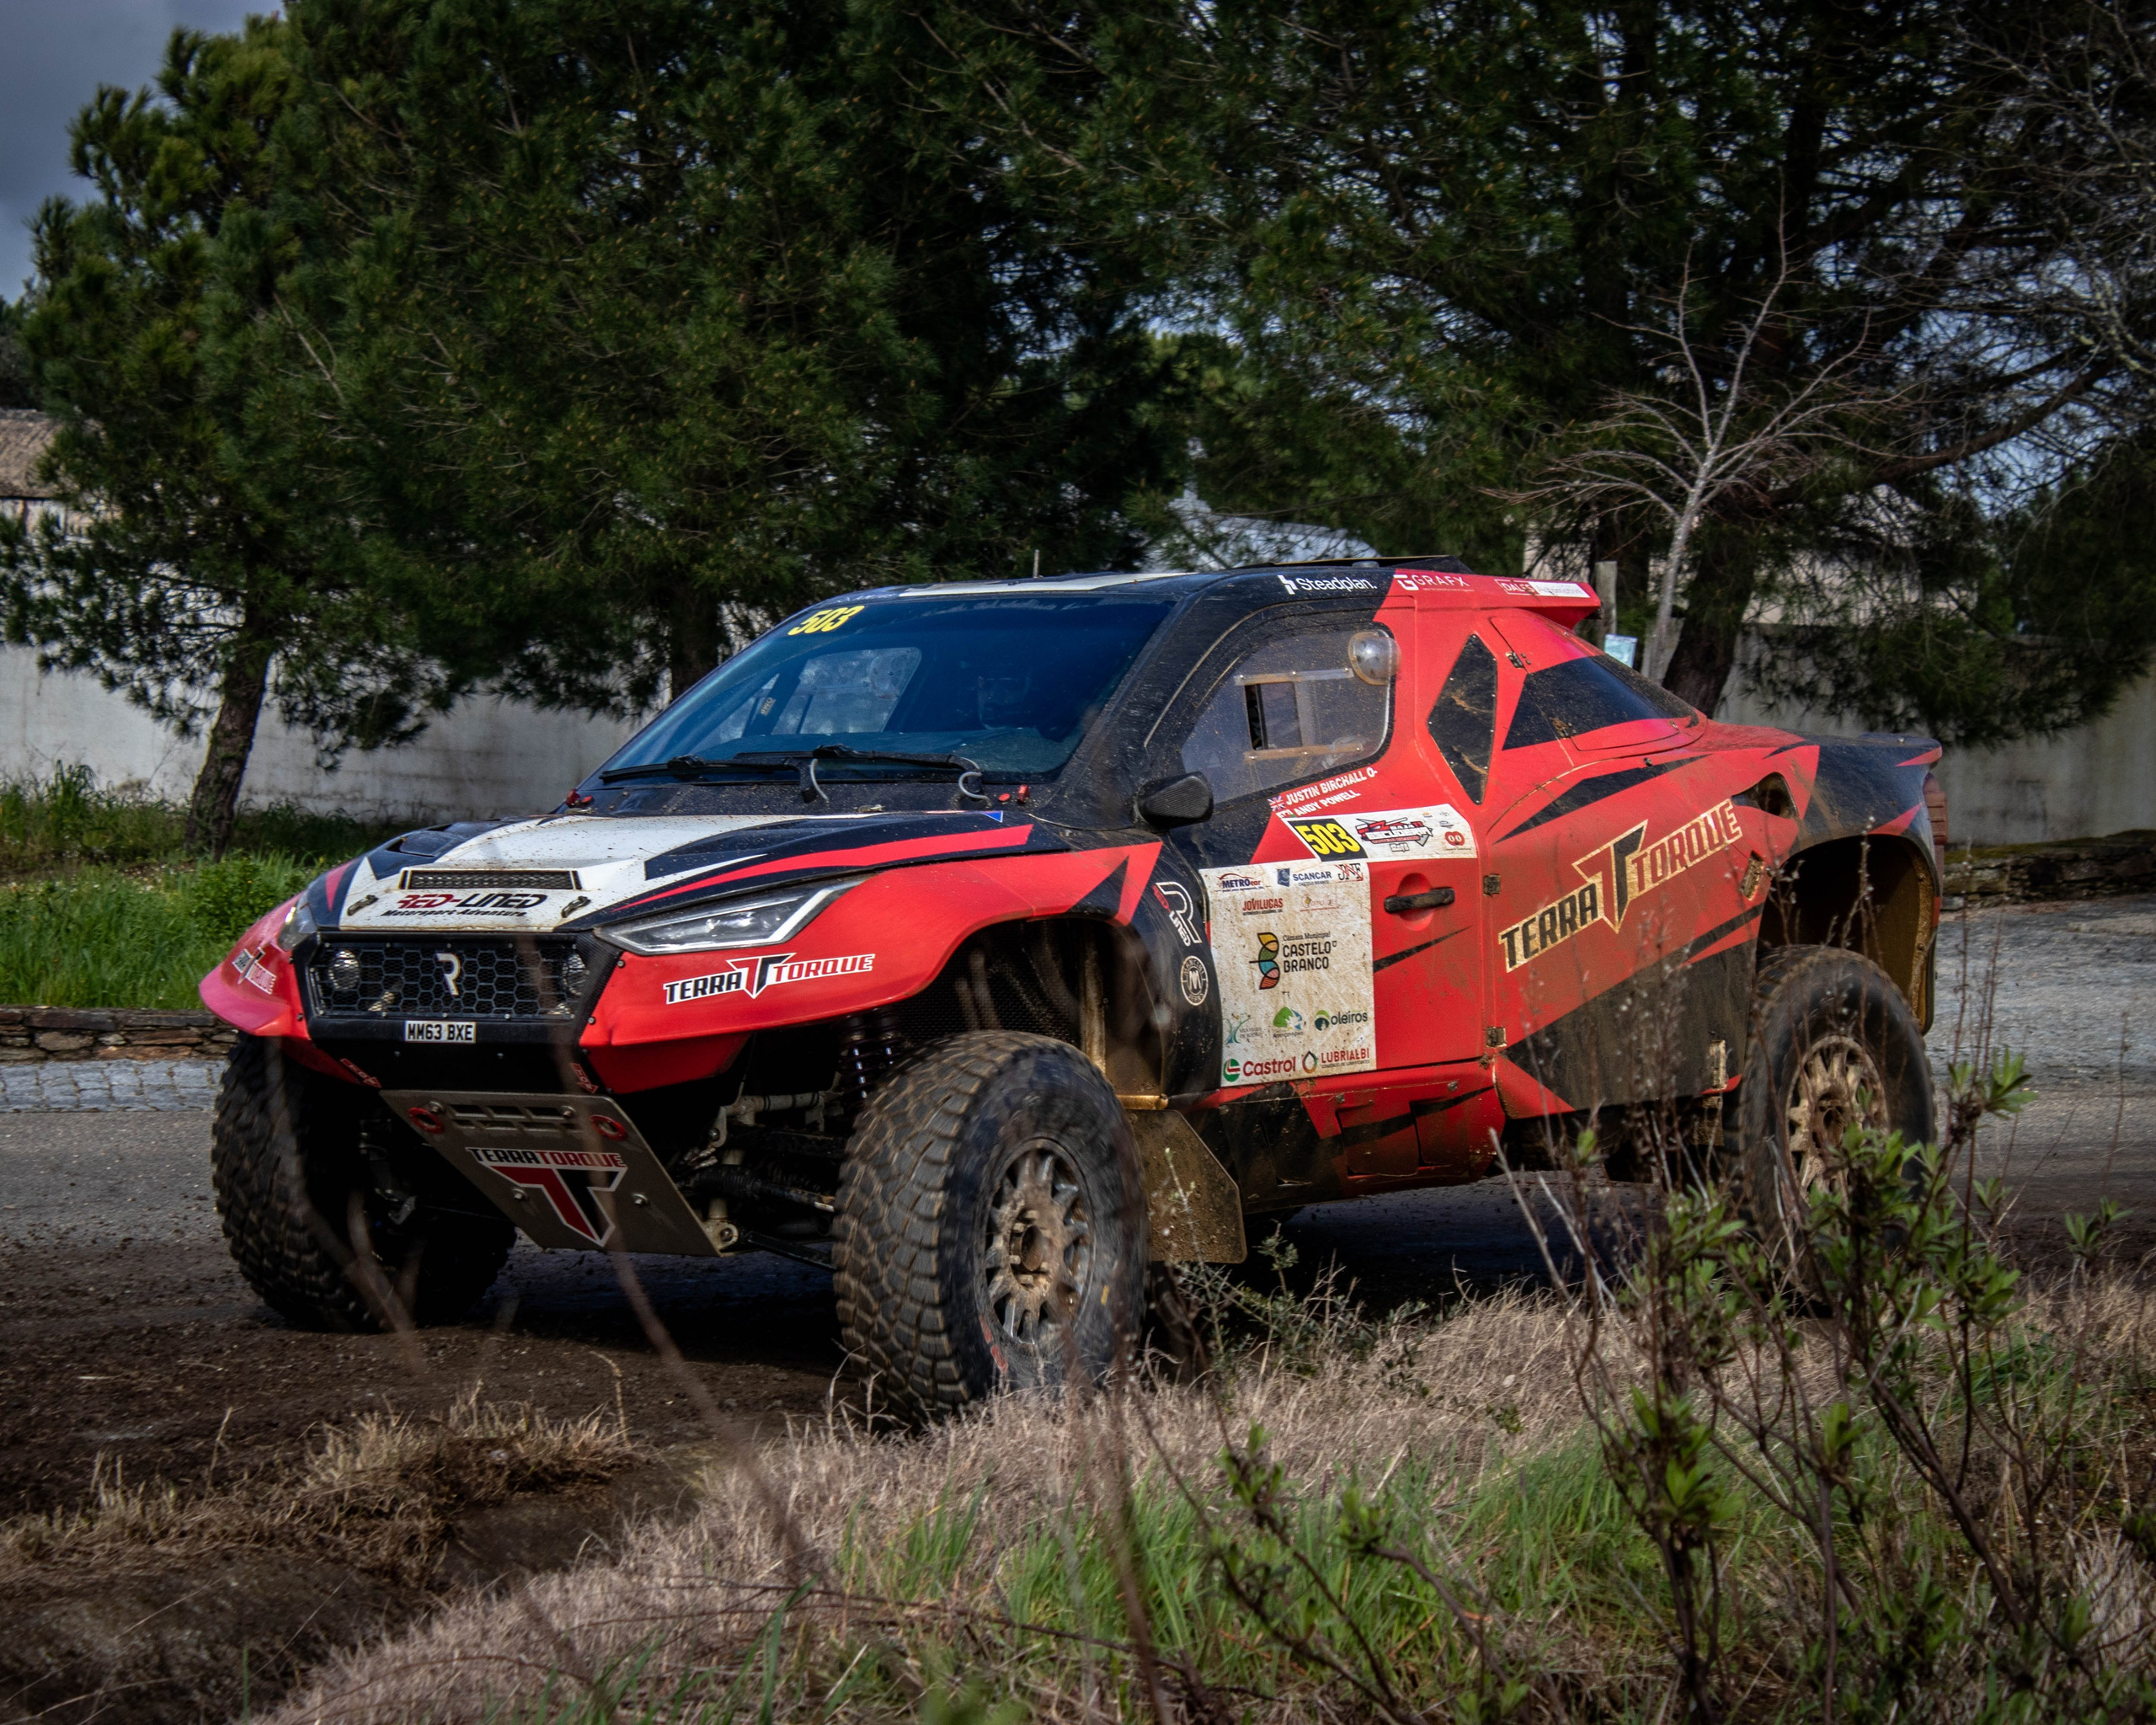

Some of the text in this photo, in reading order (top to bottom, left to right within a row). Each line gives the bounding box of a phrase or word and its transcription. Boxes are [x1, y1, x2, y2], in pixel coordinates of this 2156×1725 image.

[1411, 574, 1470, 587] GRAFX
[787, 605, 865, 636] 503
[1286, 785, 1321, 805] JUSTIN
[1320, 770, 1367, 793] BIRCHALL
[1294, 790, 1361, 816] ANDY POWELL
[1294, 823, 1361, 855] 503
[1293, 871, 1332, 881] SCANCAR
[1501, 883, 1598, 969] TERRA
[1630, 799, 1742, 891] TORQUE
[1242, 898, 1283, 911] JOVILUCAS
[1283, 941, 1331, 958] CASTELO
[1283, 956, 1329, 973] BRANCO
[665, 971, 742, 1002] TERRA
[772, 953, 876, 982] TORQUE
[1331, 1011, 1368, 1025] oleiros
[408, 1023, 473, 1041] MM63 BXE
[1243, 1055, 1296, 1077] Castrol
[469, 1149, 627, 1168] TERRA TORQUE
